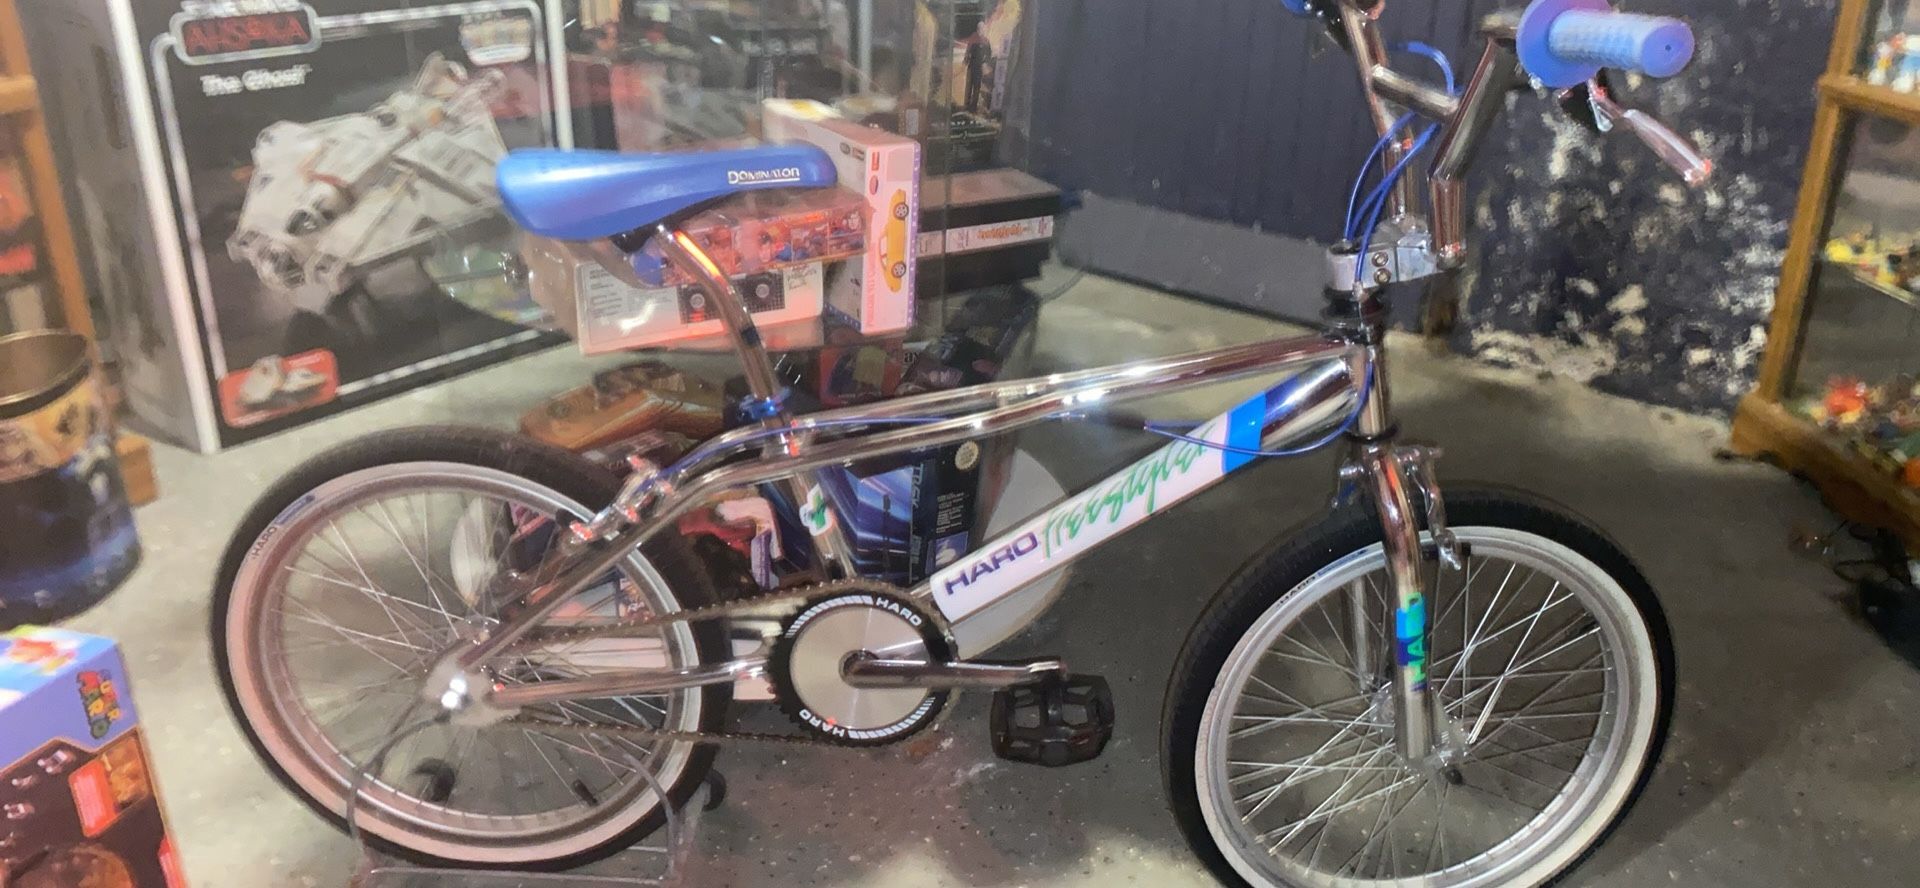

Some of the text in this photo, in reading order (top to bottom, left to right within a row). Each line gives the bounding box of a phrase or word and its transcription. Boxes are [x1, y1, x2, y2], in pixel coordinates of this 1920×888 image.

[201, 66, 306, 96] The Ghost
[252, 526, 277, 557] HARO
[944, 531, 1038, 595] HARO
[876, 597, 923, 627] HARO
[799, 709, 845, 737] HARO
